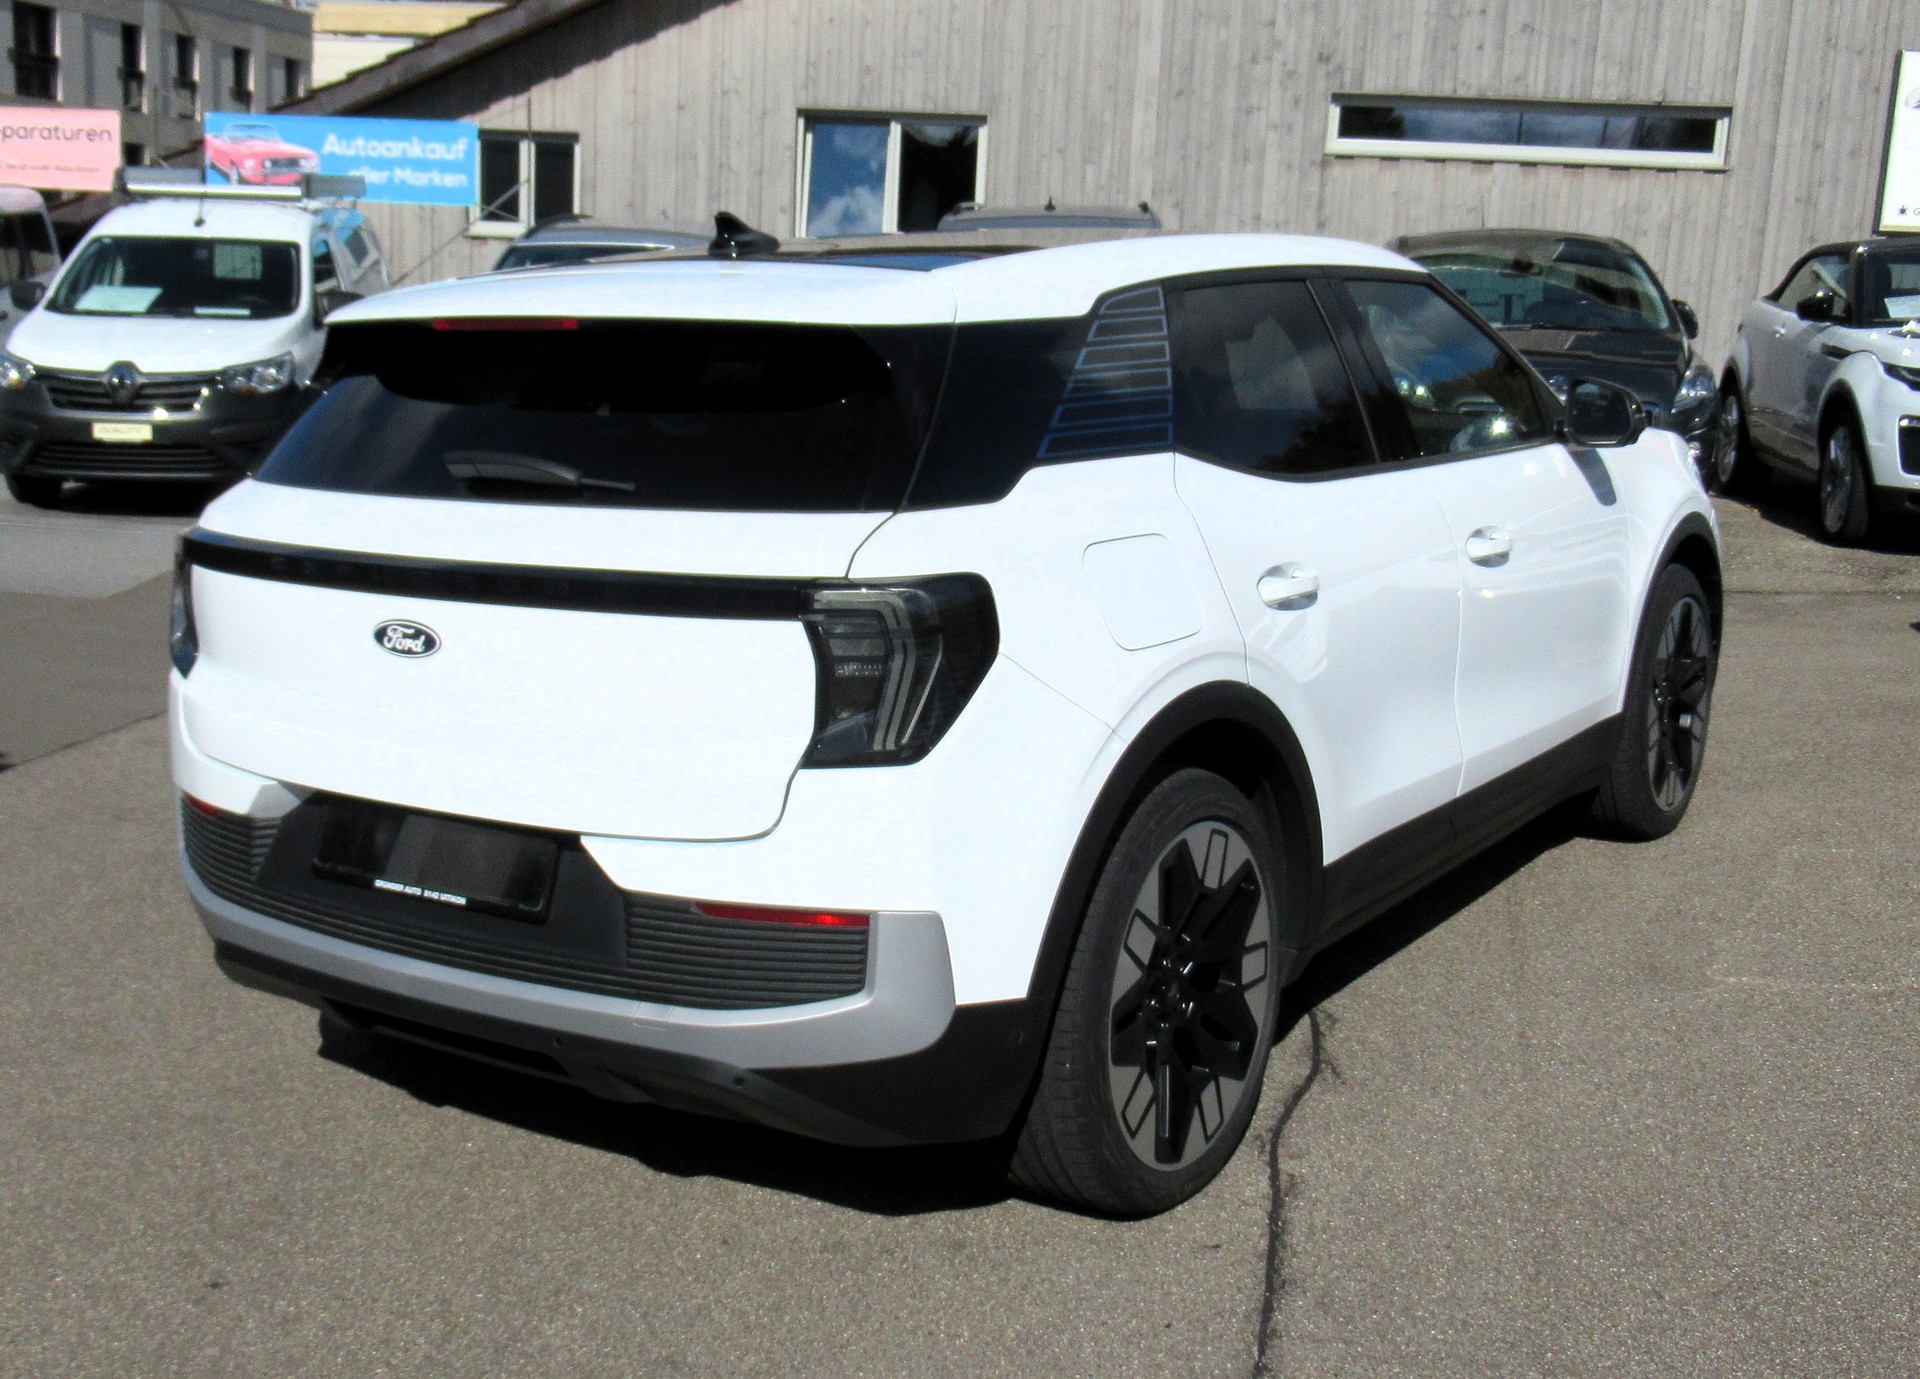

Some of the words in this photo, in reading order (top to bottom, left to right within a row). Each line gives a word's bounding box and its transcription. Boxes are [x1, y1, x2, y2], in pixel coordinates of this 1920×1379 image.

[0, 125, 113, 142] paraturen
[322, 132, 468, 161] Autoankauf
[393, 167, 468, 187] Marken
[382, 625, 427, 652] Ford
